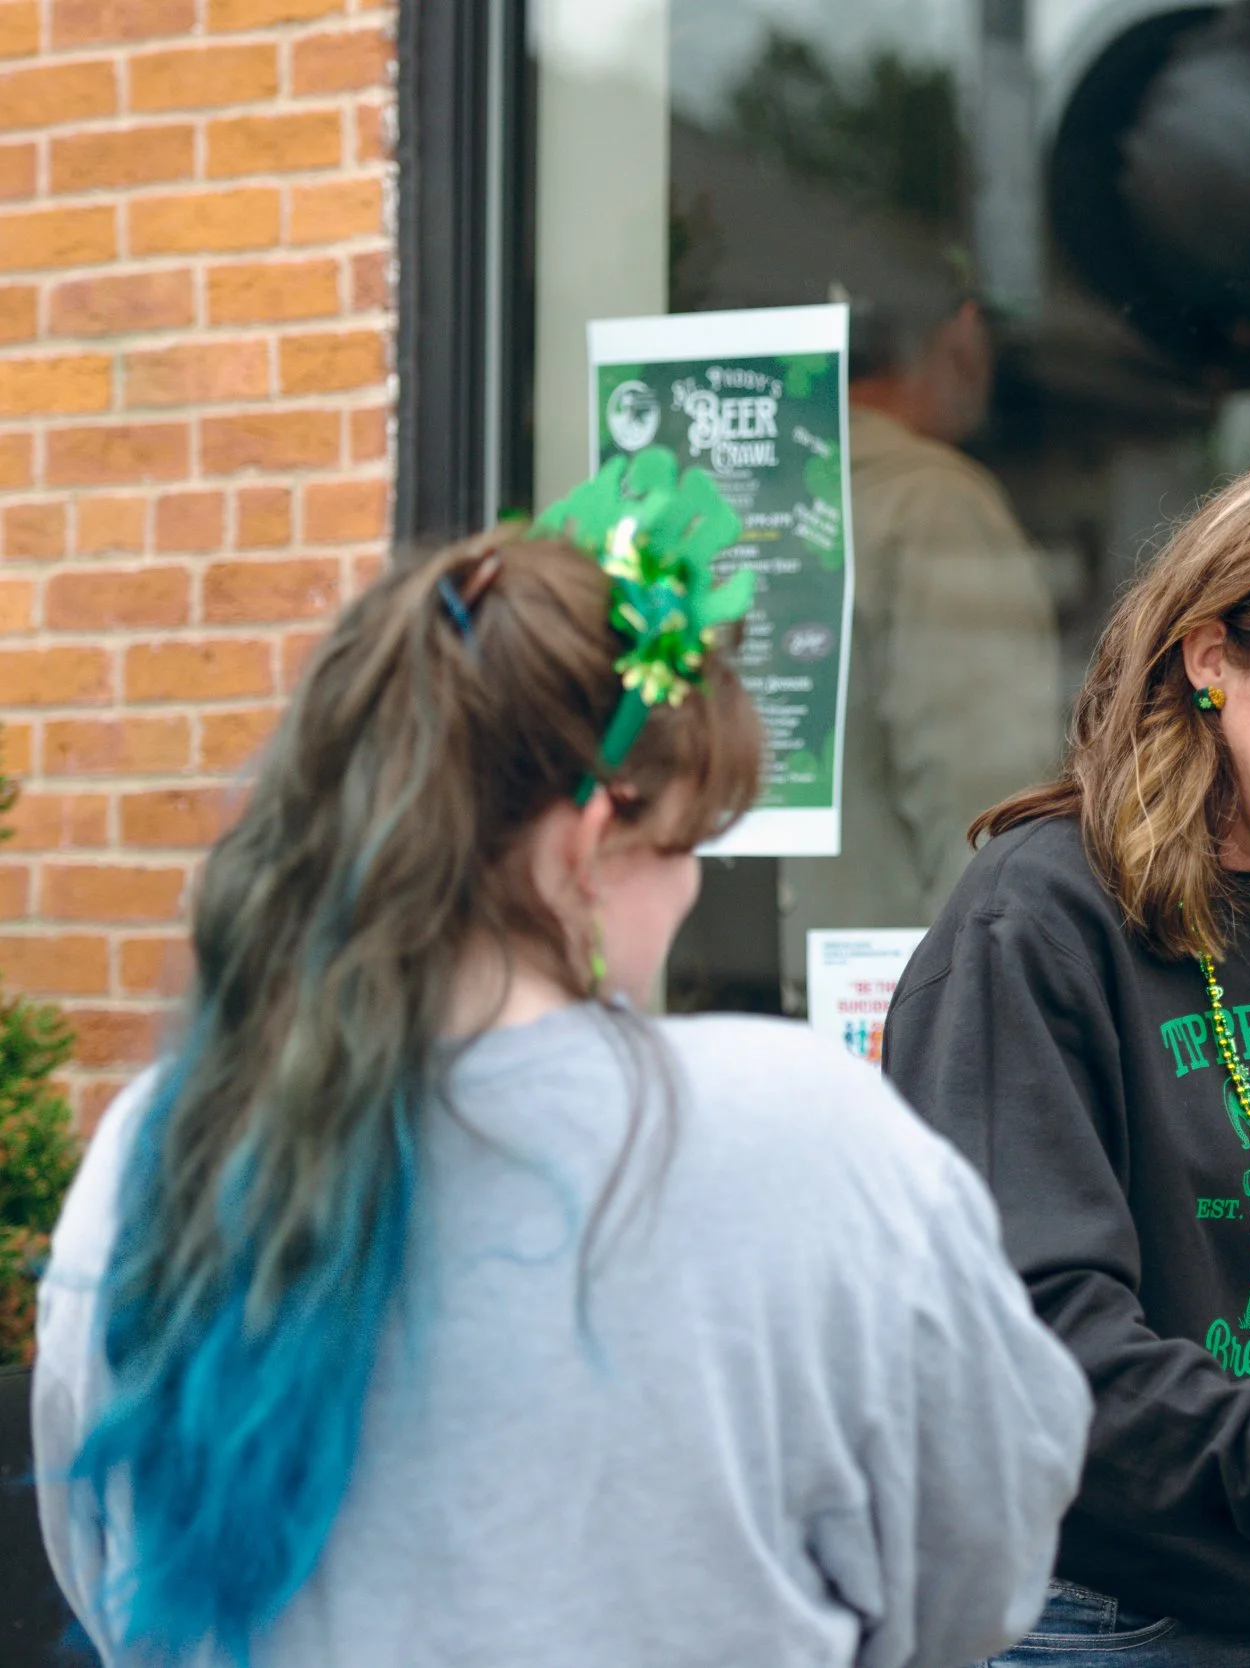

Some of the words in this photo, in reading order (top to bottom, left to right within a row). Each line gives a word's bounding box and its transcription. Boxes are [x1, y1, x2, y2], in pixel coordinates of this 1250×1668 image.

[683, 390, 779, 457] BEER
[711, 441, 780, 475] CRAWL
[1196, 1198, 1244, 1220] EST.
